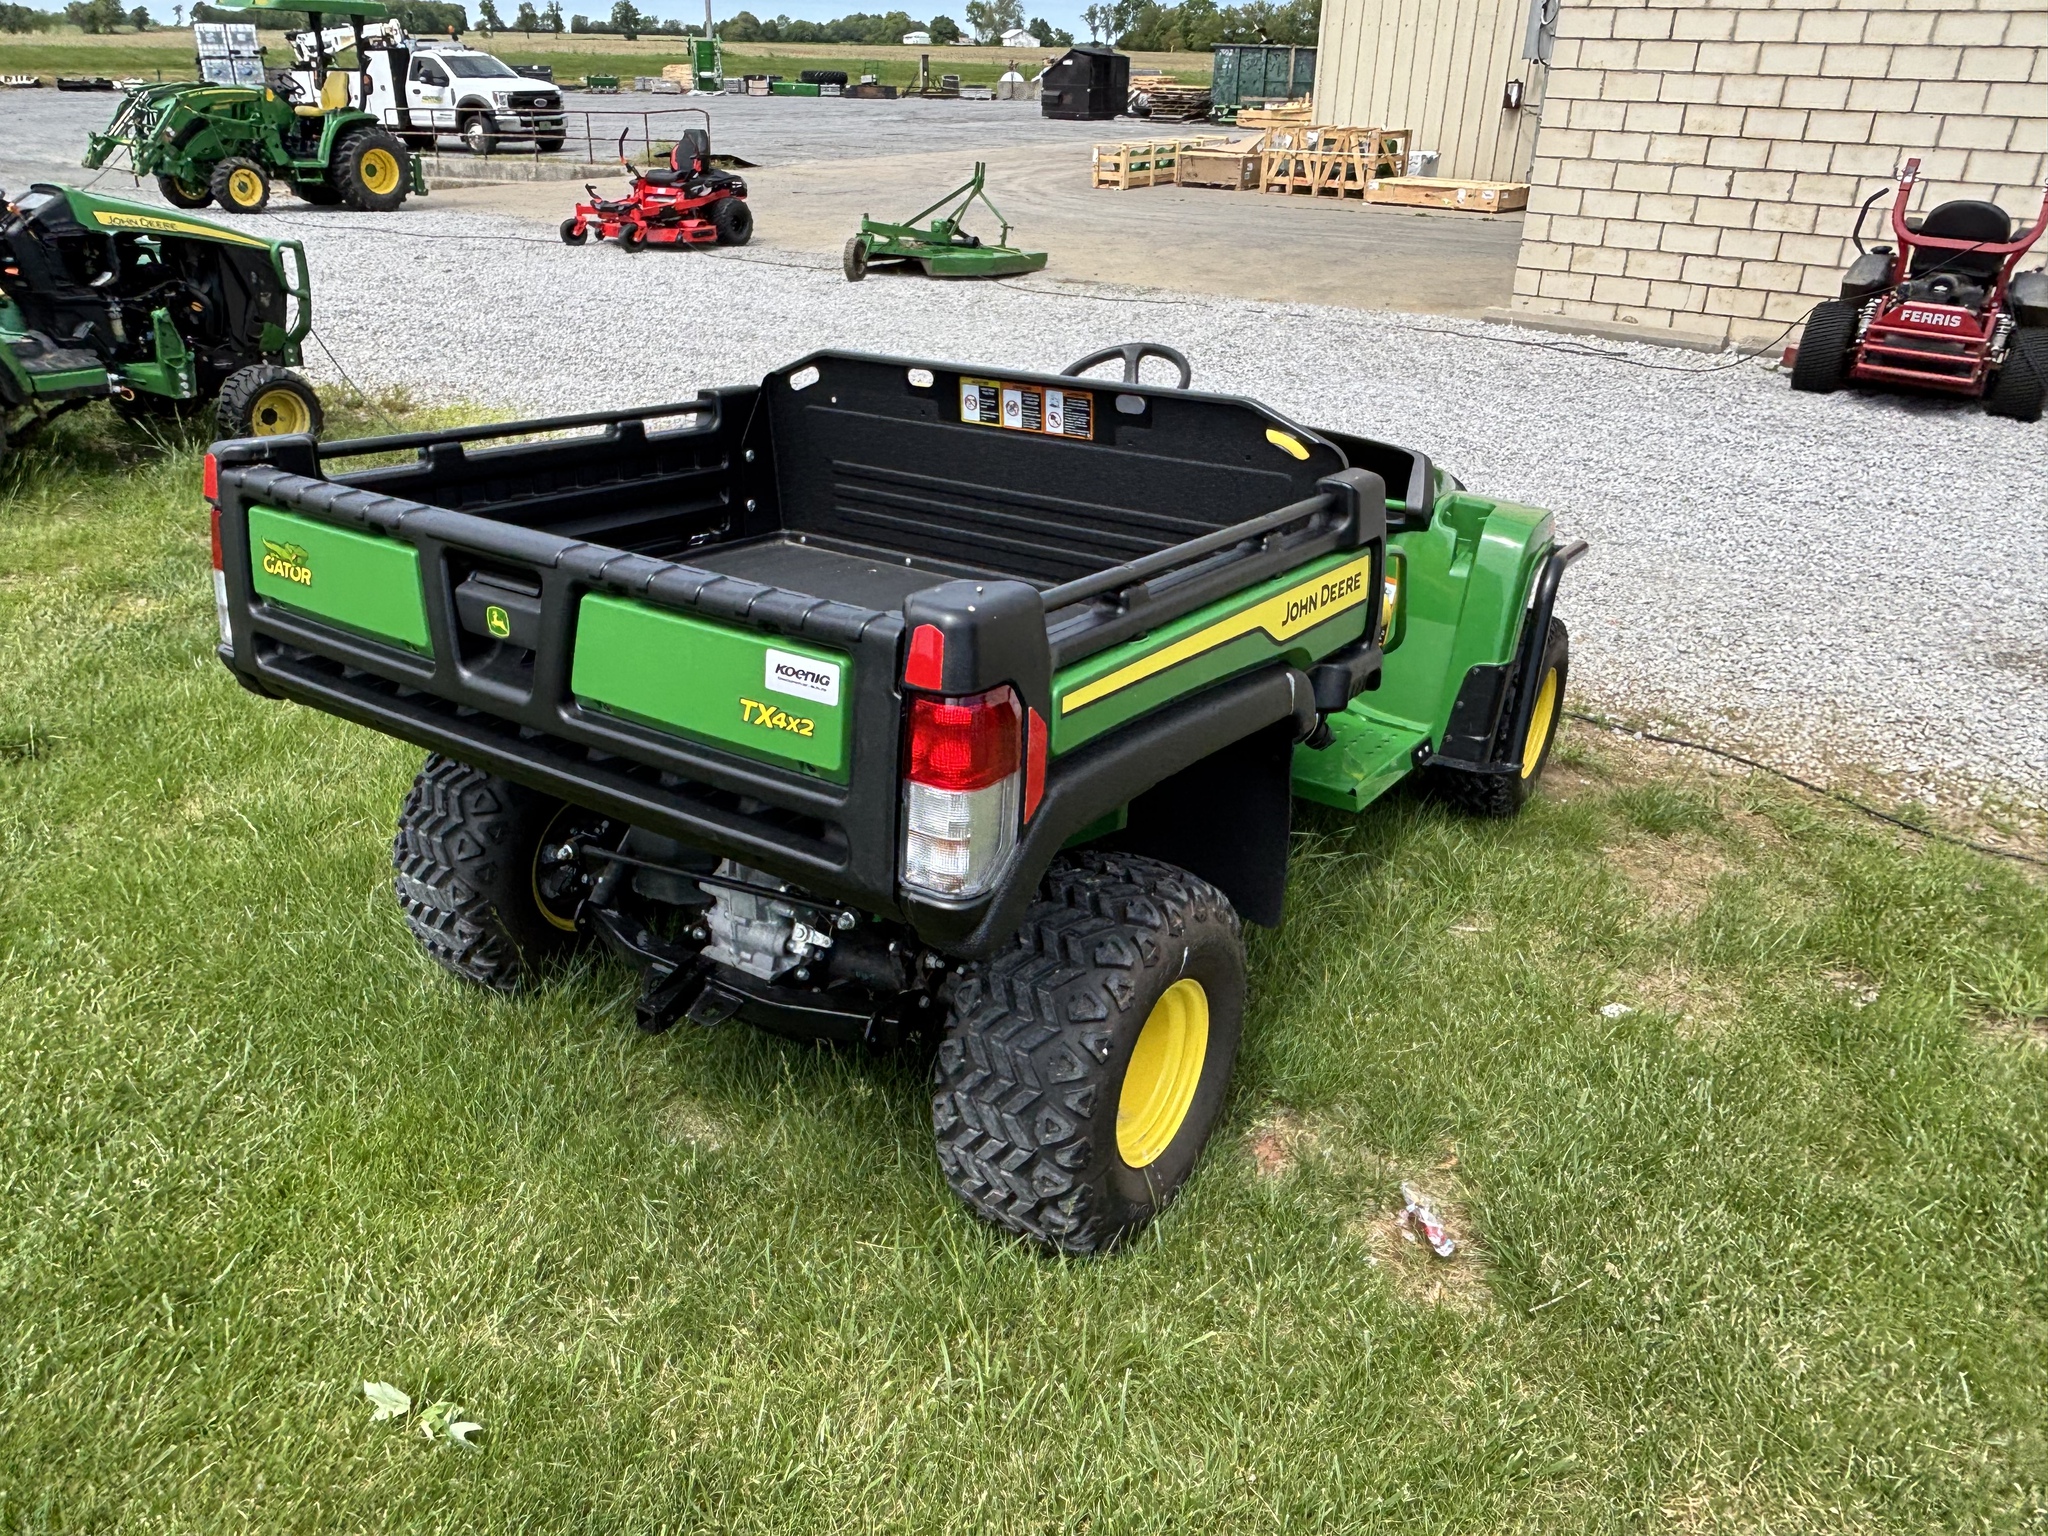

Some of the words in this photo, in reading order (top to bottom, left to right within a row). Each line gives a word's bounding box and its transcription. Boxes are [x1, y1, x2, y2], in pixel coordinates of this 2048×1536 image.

[108, 215, 138, 227] JOHN
[140, 217, 178, 231] DEERE
[1900, 309, 1962, 327] FERRIS
[263, 554, 312, 586] GATOR
[1281, 592, 1318, 627] JOHN
[1320, 571, 1362, 607] DEERE
